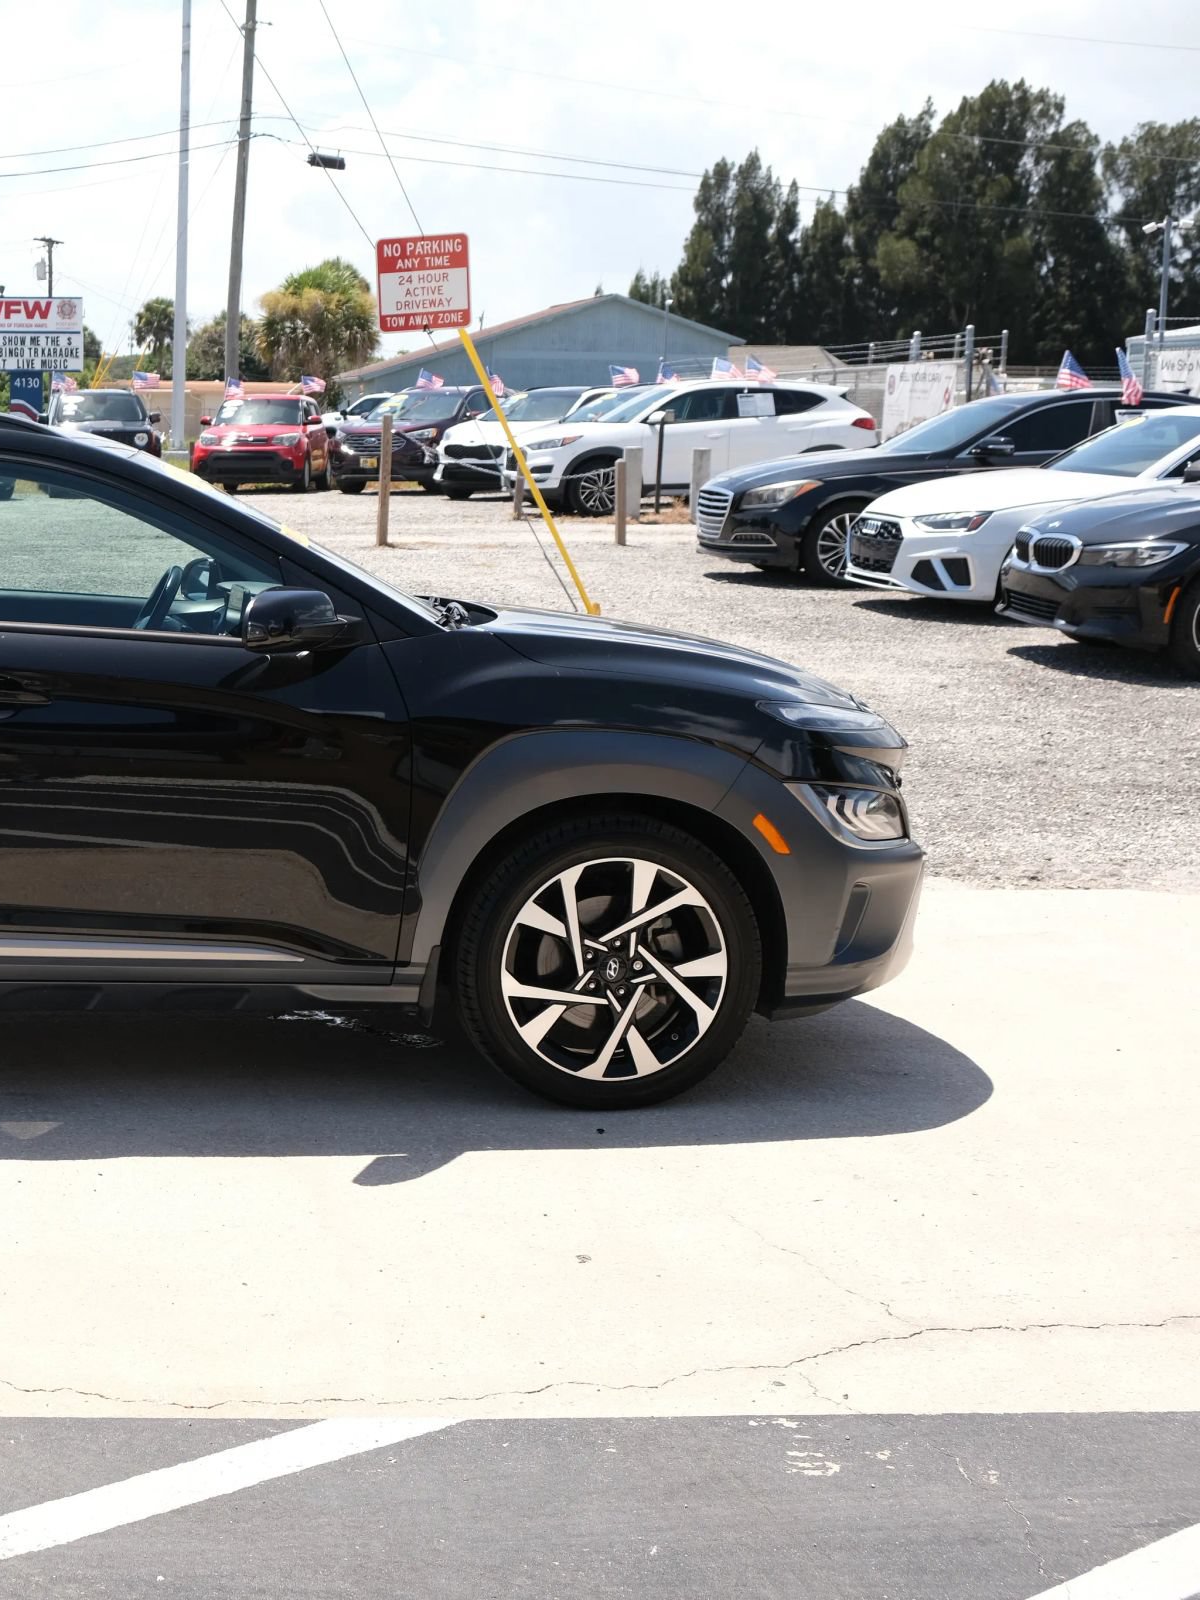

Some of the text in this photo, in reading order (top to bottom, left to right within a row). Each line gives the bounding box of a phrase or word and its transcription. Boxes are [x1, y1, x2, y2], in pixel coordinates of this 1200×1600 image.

[383, 238, 462, 257] NO PARKING
[396, 255, 450, 270] ANY TIME
[398, 272, 449, 286] 24 HOUR
[404, 285, 444, 298] ACTIVE
[395, 297, 453, 311] DRIVEWAY
[386, 311, 464, 328] TOW AWAY ZONE
[2, 335, 26, 346] SHOW
[30, 335, 40, 346] ME
[45, 335, 60, 346] THE
[41, 347, 80, 358] KARAOKE
[17, 359, 35, 369] LIVE
[41, 359, 68, 369] MUSIC
[14, 377, 40, 388] 4130
